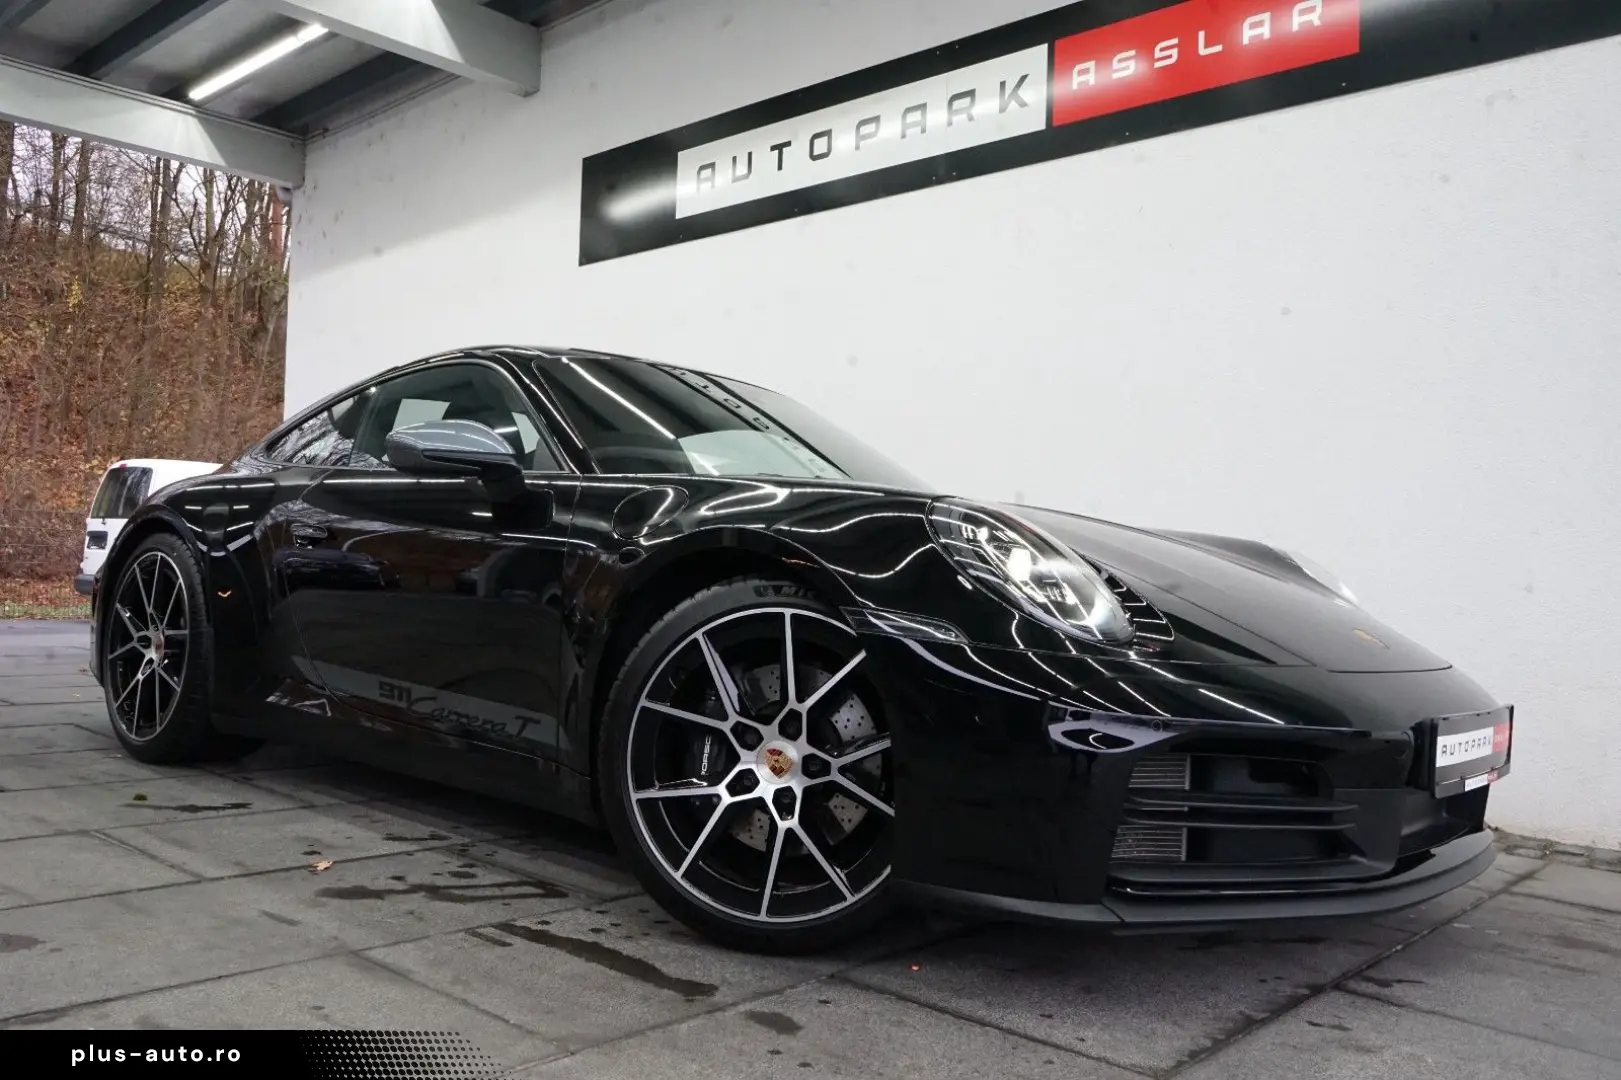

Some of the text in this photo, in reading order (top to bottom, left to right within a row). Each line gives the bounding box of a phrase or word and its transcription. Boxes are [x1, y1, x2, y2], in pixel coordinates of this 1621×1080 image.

[695, 0, 1324, 193] AUTOPARK ASSLAR
[379, 682, 541, 739] 911 Carrera T
